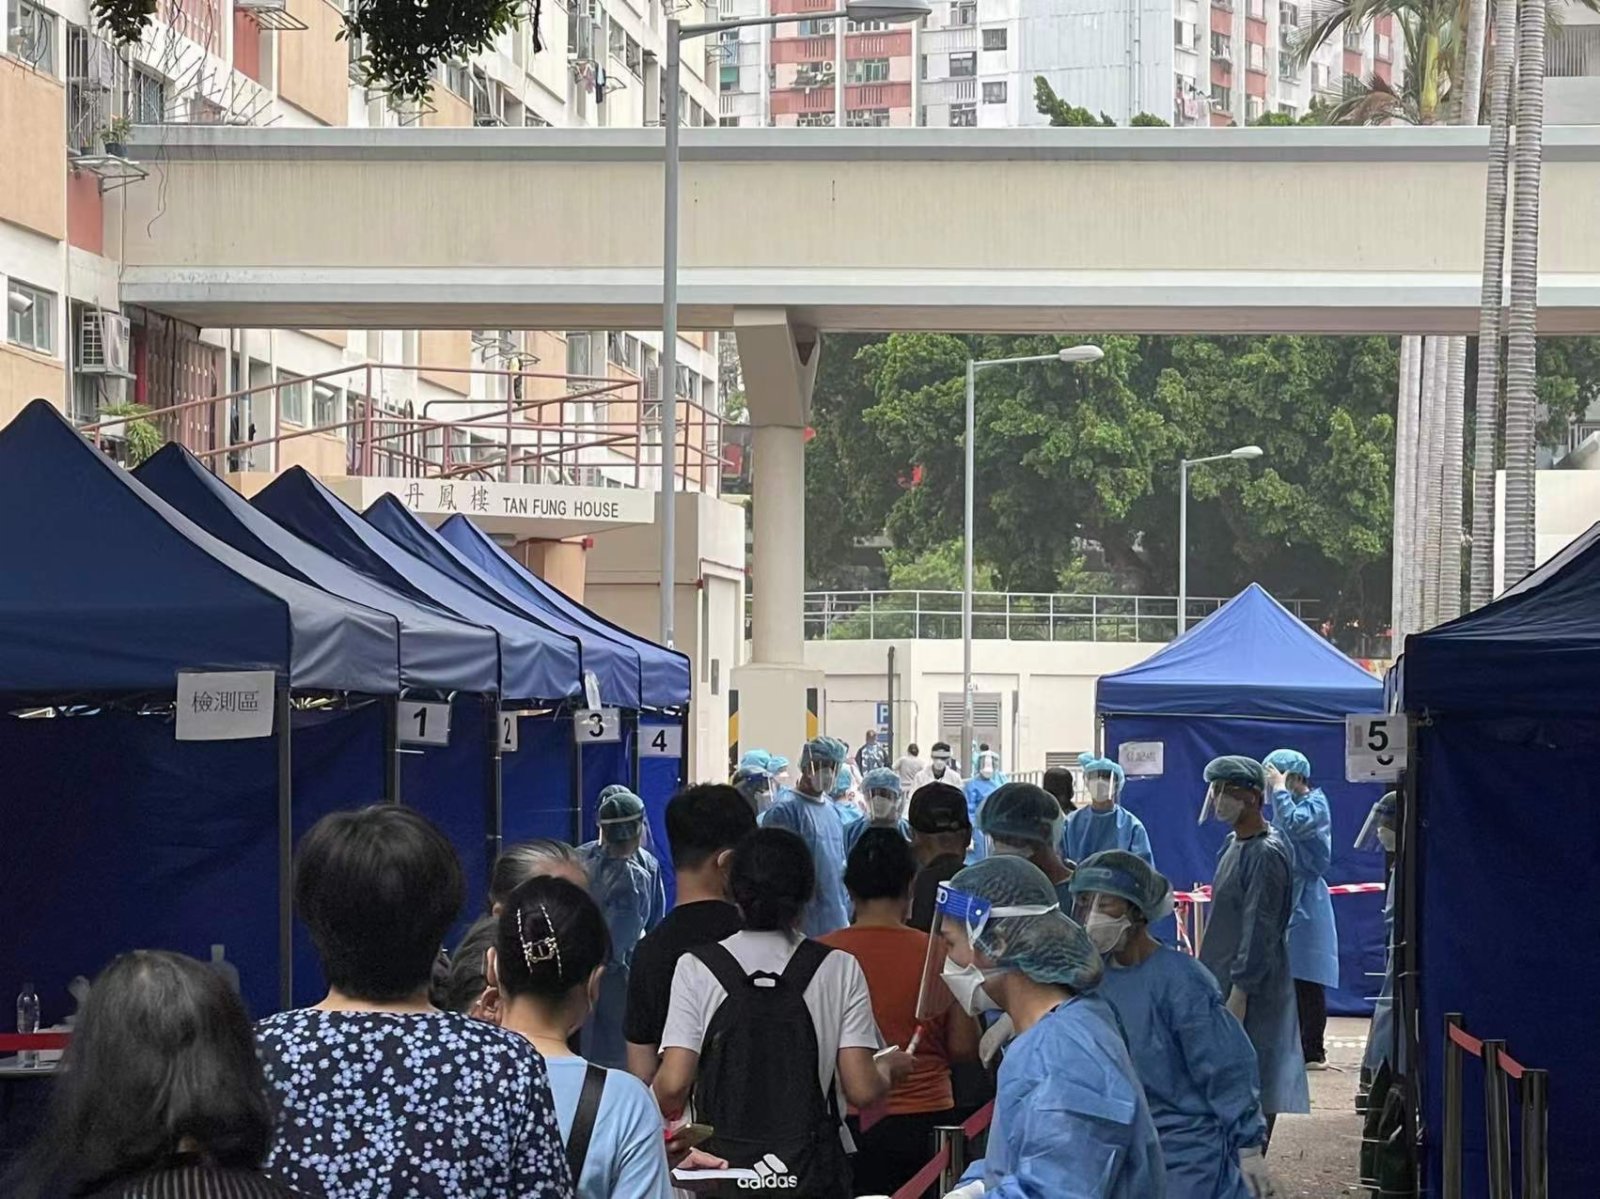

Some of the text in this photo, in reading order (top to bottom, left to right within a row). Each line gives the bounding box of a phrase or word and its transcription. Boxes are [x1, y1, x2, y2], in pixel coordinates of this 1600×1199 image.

[404, 482, 490, 512] 丹鳳樓
[503, 497, 619, 518] TAN FUNG HOUSE
[192, 690, 259, 714] 檢測區
[880, 704, 889, 722] P
[413, 707, 427, 737] 1
[504, 717, 511, 744] 2
[589, 713, 604, 737] 3
[652, 729, 667, 752] 4
[1368, 720, 1389, 752] 5
[737, 1172, 798, 1190] adidas
